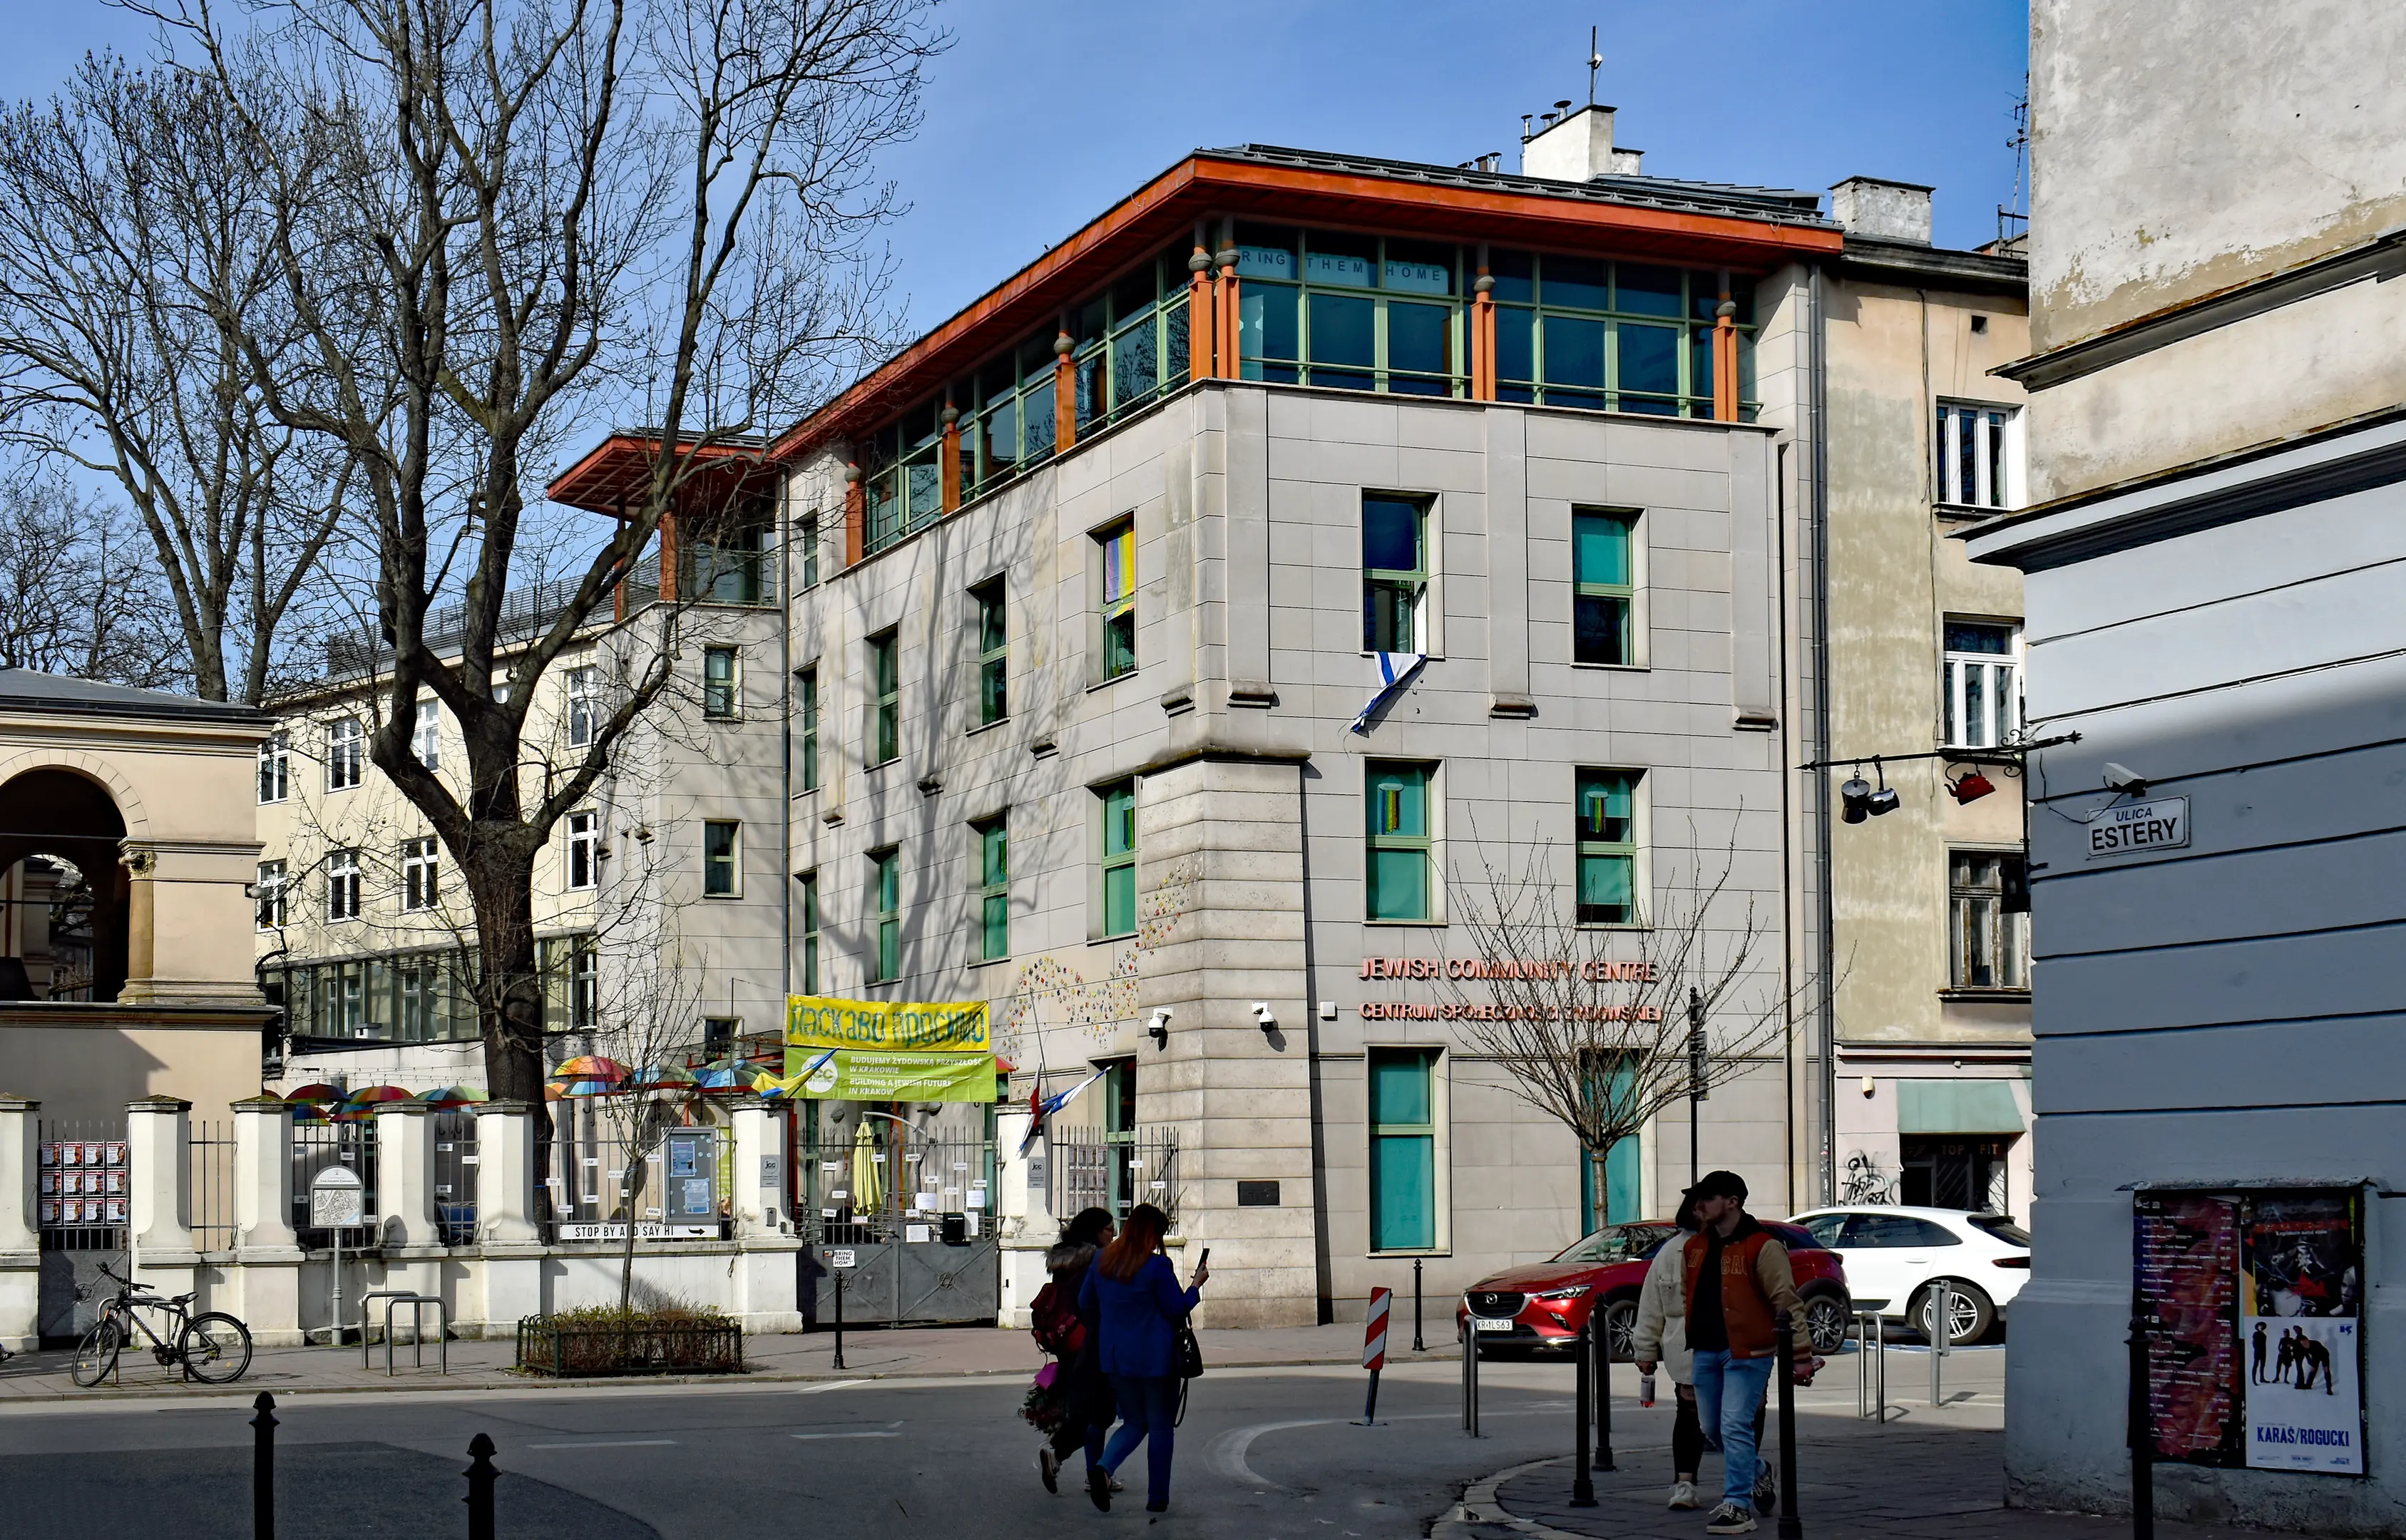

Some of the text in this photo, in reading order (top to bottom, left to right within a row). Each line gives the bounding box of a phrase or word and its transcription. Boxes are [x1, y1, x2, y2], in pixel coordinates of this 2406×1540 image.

[1242, 250, 1440, 282] RING THEM HOME
[2116, 806, 2152, 822] ULICA
[2092, 817, 2177, 851] ESTERY
[1358, 957, 1659, 982] JEWISH COMMUNITY CENTRE
[1359, 1002, 1439, 1021] CENTRUM
[850, 1056, 983, 1067] BUDUJEMY ŻYDOWSKĄ PRZYSZŁOŚĆ
[859, 1065, 900, 1074] KRAKOWIE
[849, 1077, 886, 1086] BUILDING
[1940, 1144, 1999, 1156] TOP FIT
[764, 1161, 776, 1169] jcc
[575, 1226, 675, 1237] STOP BY AD SAY HI
[1478, 1320, 1486, 1329] KR
[2256, 1426, 2350, 1447] KARAŚ/ROGUCKI
